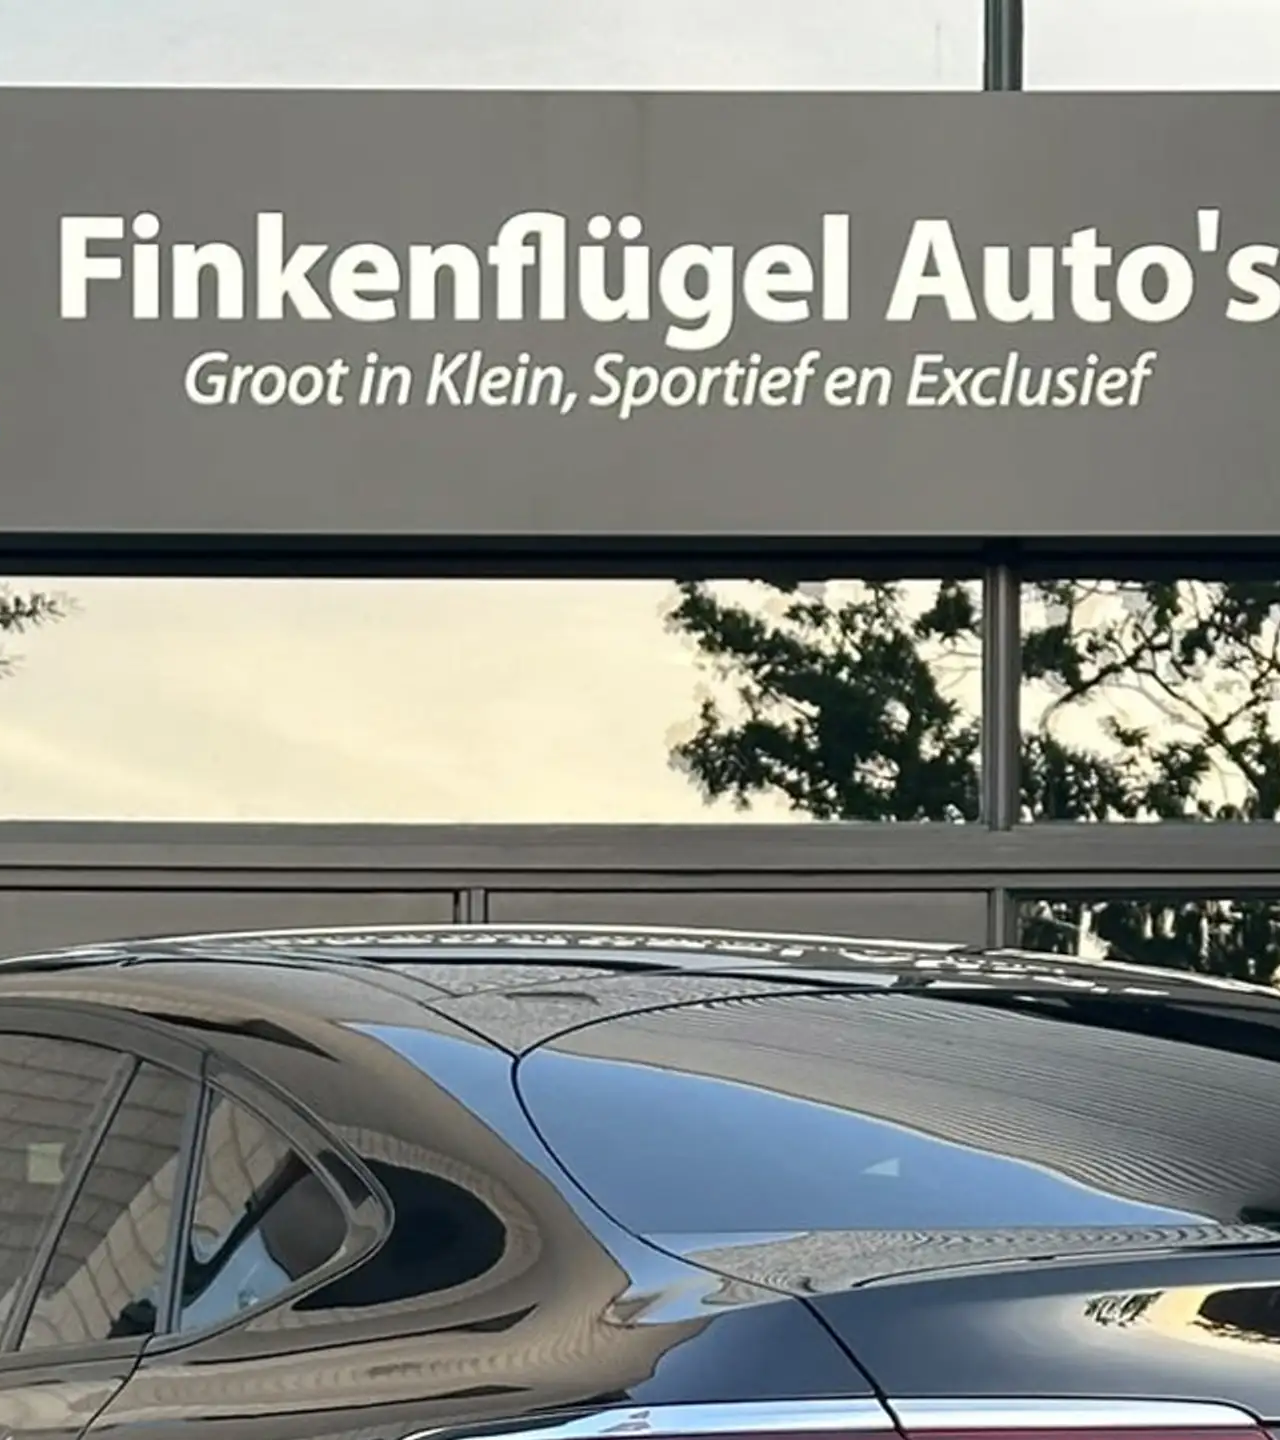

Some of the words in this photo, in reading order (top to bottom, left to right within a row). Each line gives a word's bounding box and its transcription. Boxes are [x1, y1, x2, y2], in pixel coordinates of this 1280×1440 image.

[60, 210, 849, 351] Finkenflügel
[184, 350, 350, 406] Groot
[359, 351, 412, 405] in
[425, 350, 579, 416] Klein,
[588, 347, 821, 420] Sportief
[824, 366, 892, 407] en
[906, 350, 1158, 407] Exclusief
